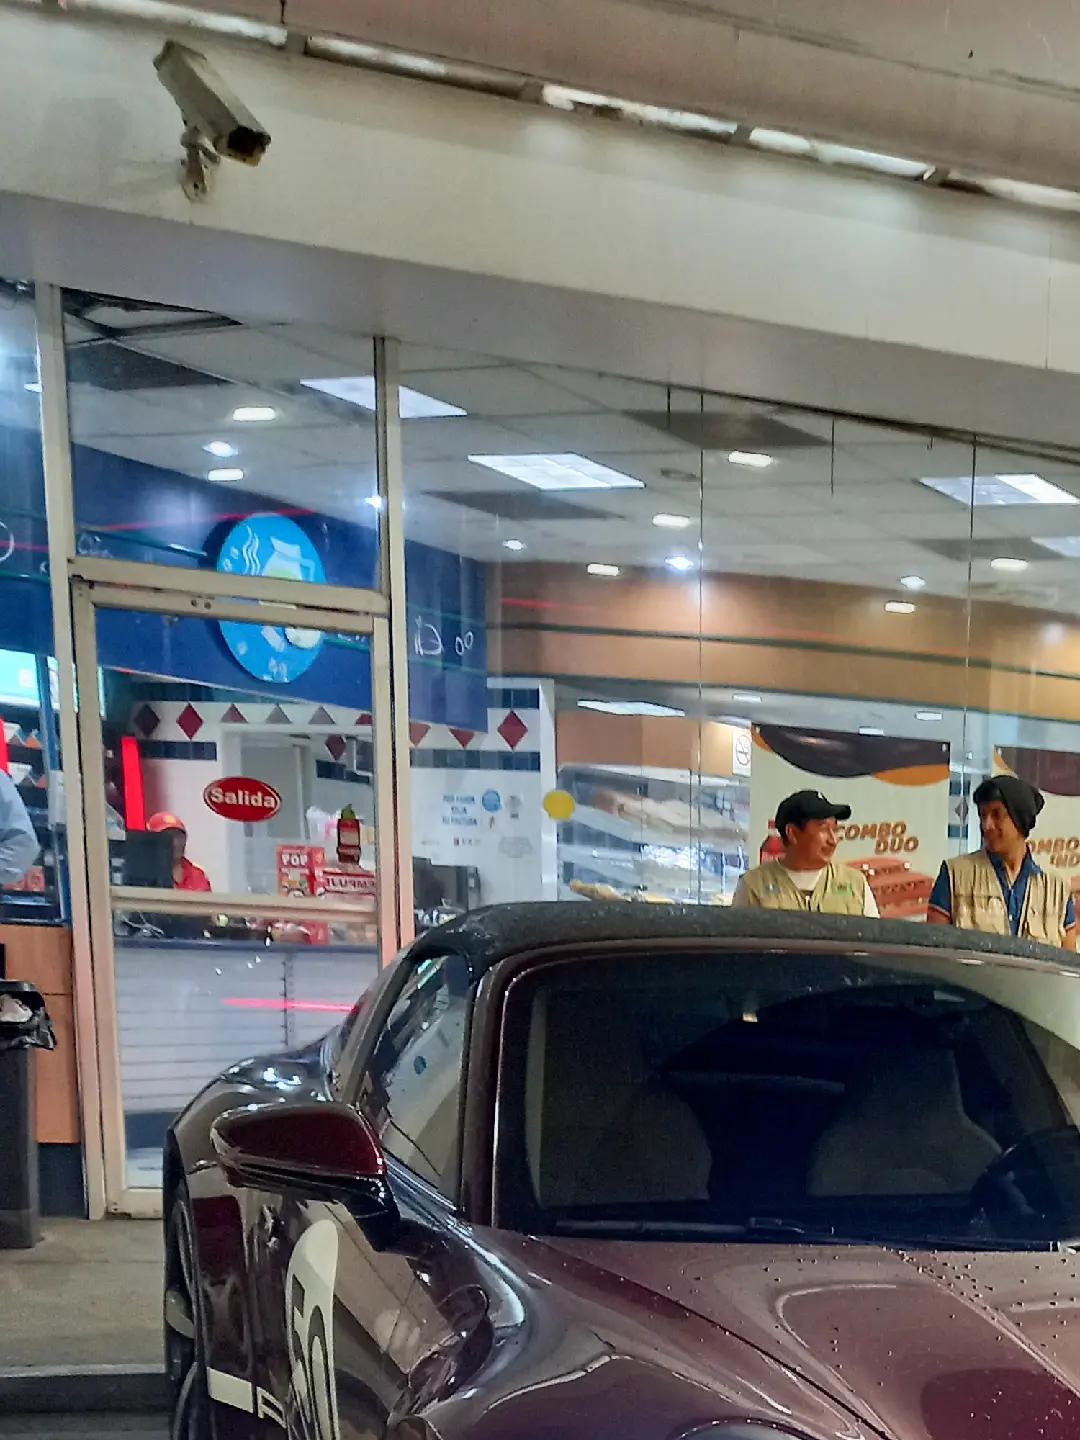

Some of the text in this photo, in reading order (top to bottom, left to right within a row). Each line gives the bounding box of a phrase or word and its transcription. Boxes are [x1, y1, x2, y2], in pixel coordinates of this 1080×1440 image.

[210, 787, 275, 809] Salida
[875, 837, 919, 854] DUO
[1026, 836, 1080, 855] OMBO
